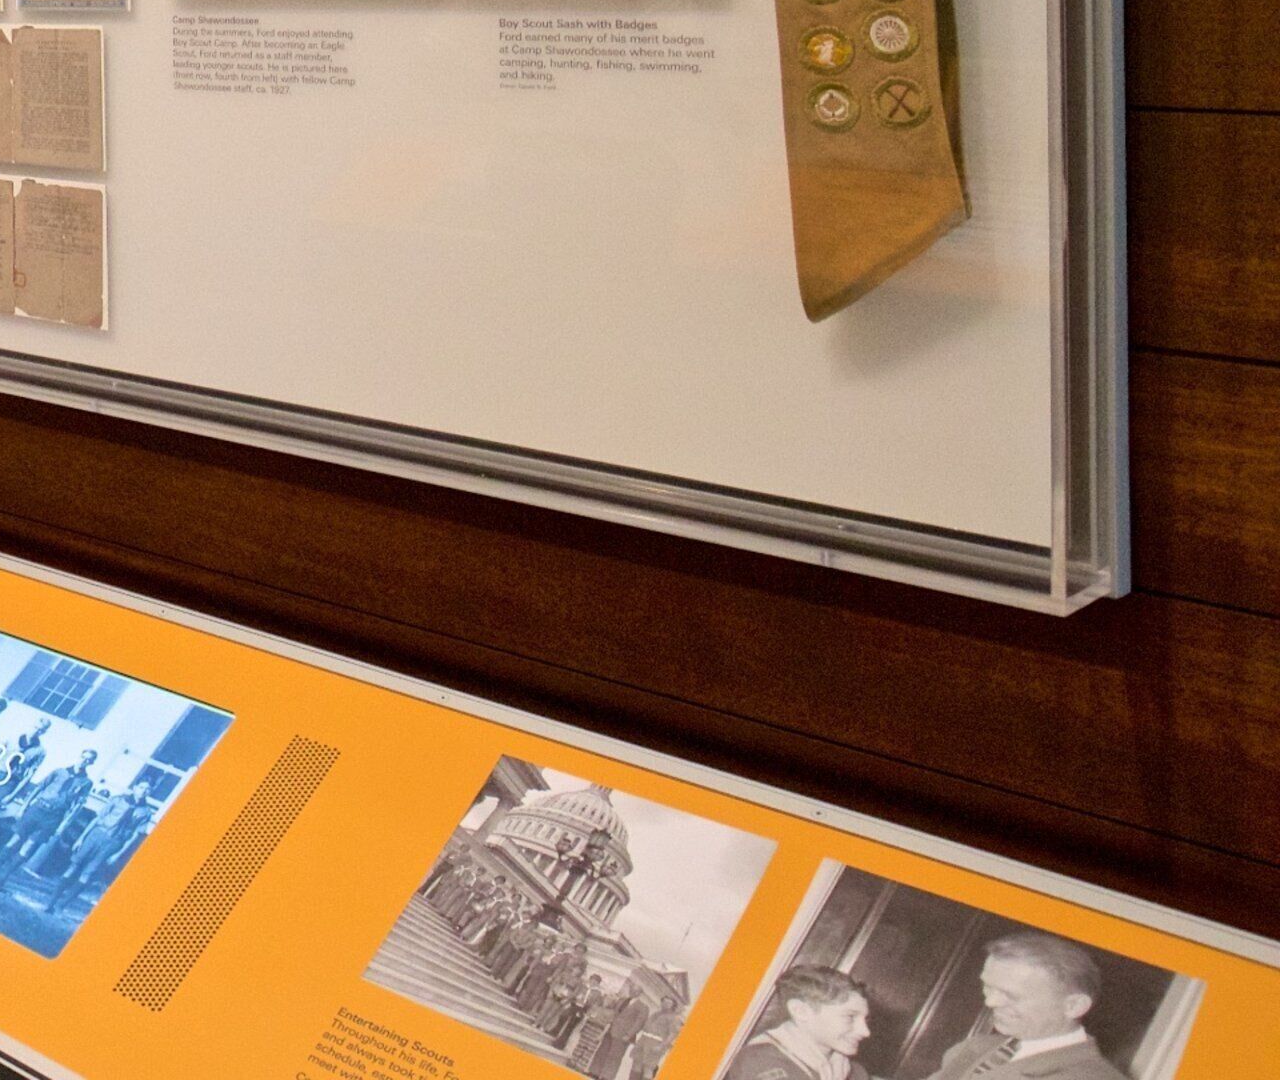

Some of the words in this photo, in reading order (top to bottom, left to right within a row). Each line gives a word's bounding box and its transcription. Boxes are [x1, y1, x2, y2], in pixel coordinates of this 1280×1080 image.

[499, 19, 519, 31] Boy
[522, 19, 553, 29] Scout
[557, 19, 583, 29] Sash
[586, 19, 611, 30] with
[616, 19, 657, 32] Badges
[499, 32, 522, 42] Ford
[525, 33, 560, 42] earned
[564, 34, 592, 45] many
[597, 33, 607, 43] of
[611, 34, 626, 43] his
[630, 34, 659, 44] merit
[662, 35, 704, 46] badges
[331, 1018, 397, 1056] Throughout
[398, 1050, 416, 1065] his
[419, 1059, 439, 1077] life,
[337, 1006, 409, 1047] Entertaining
[411, 1041, 455, 1067] Scouts
[307, 1053, 338, 1073] meet
[315, 1042, 368, 1073] schedule,
[322, 1031, 346, 1046] and
[346, 1042, 386, 1066] always
[388, 1062, 415, 1080] took
